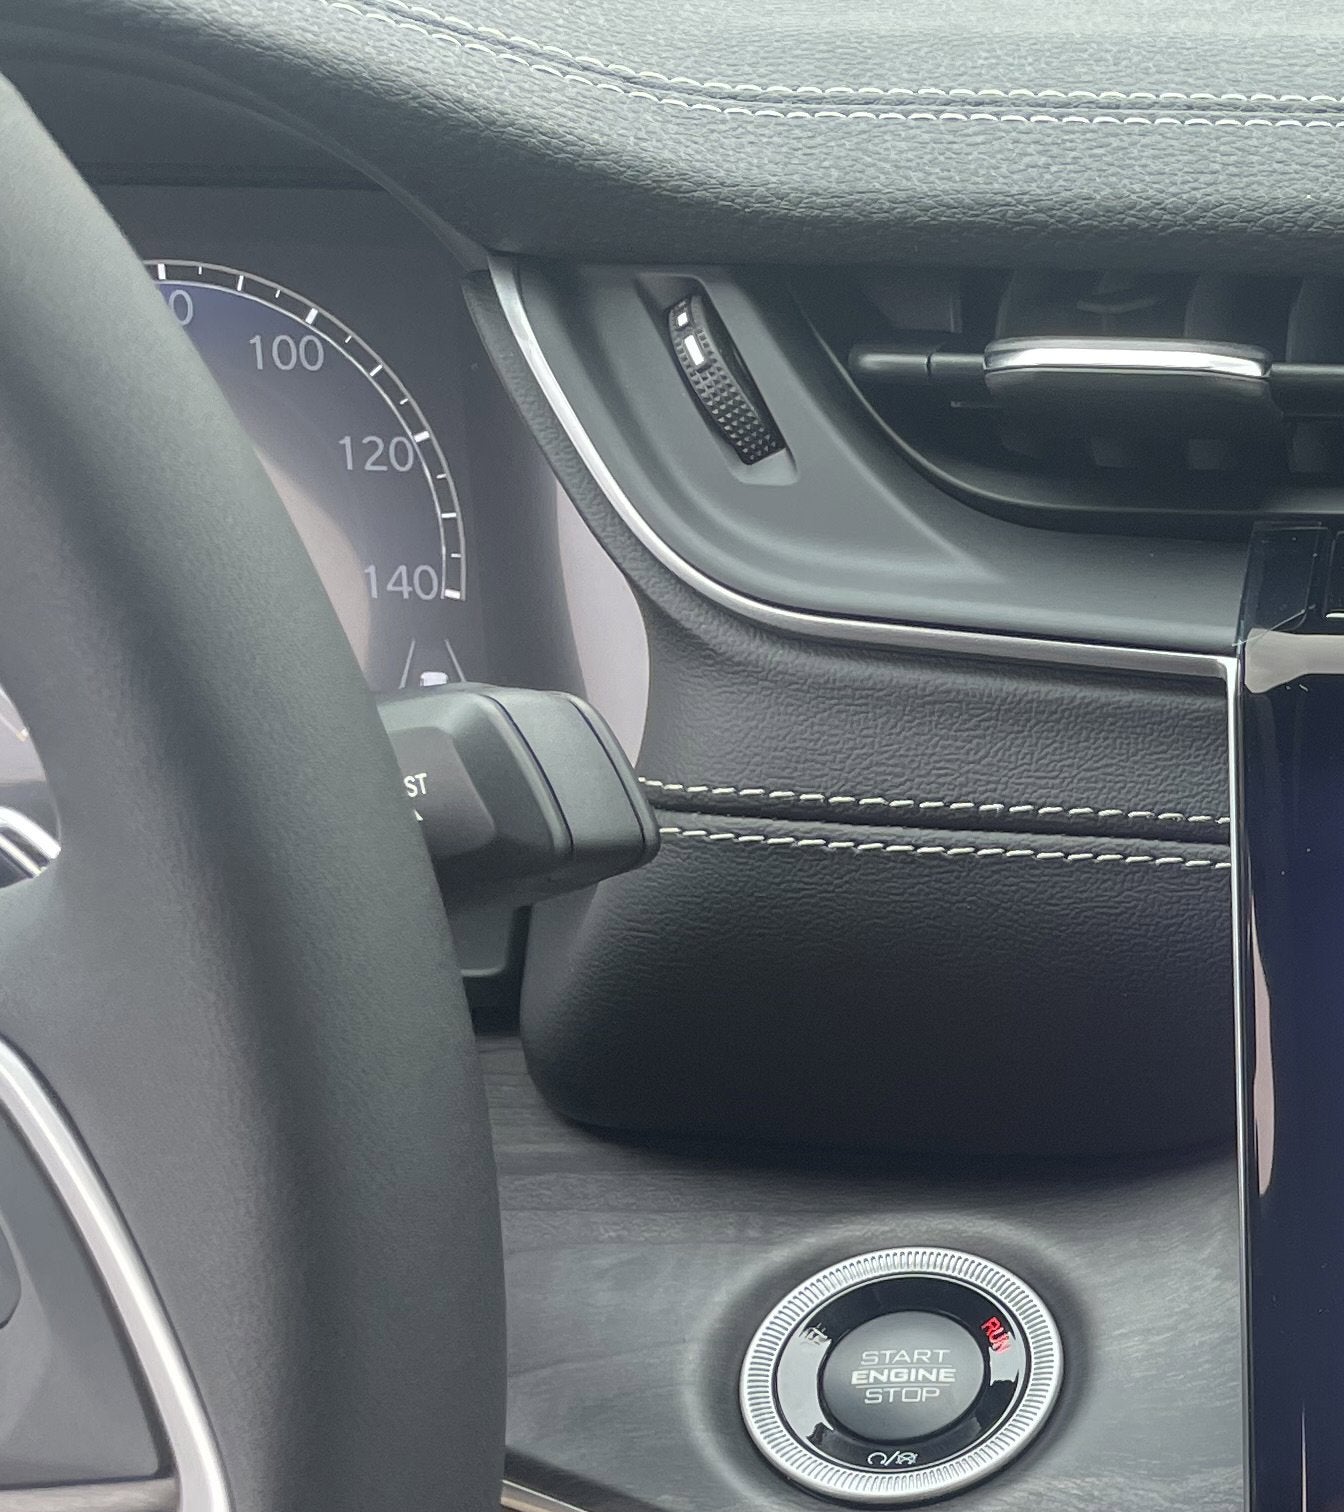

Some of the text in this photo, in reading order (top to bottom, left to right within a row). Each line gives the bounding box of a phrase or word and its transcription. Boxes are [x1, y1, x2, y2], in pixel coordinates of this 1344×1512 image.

[168, 288, 194, 327] 0
[249, 334, 325, 372] 100
[338, 435, 414, 472] 120
[363, 564, 439, 601] 140
[403, 772, 428, 798] ST
[860, 1349, 950, 1366] START
[850, 1367, 957, 1385] ENGINE
[864, 1386, 941, 1404] STOP
